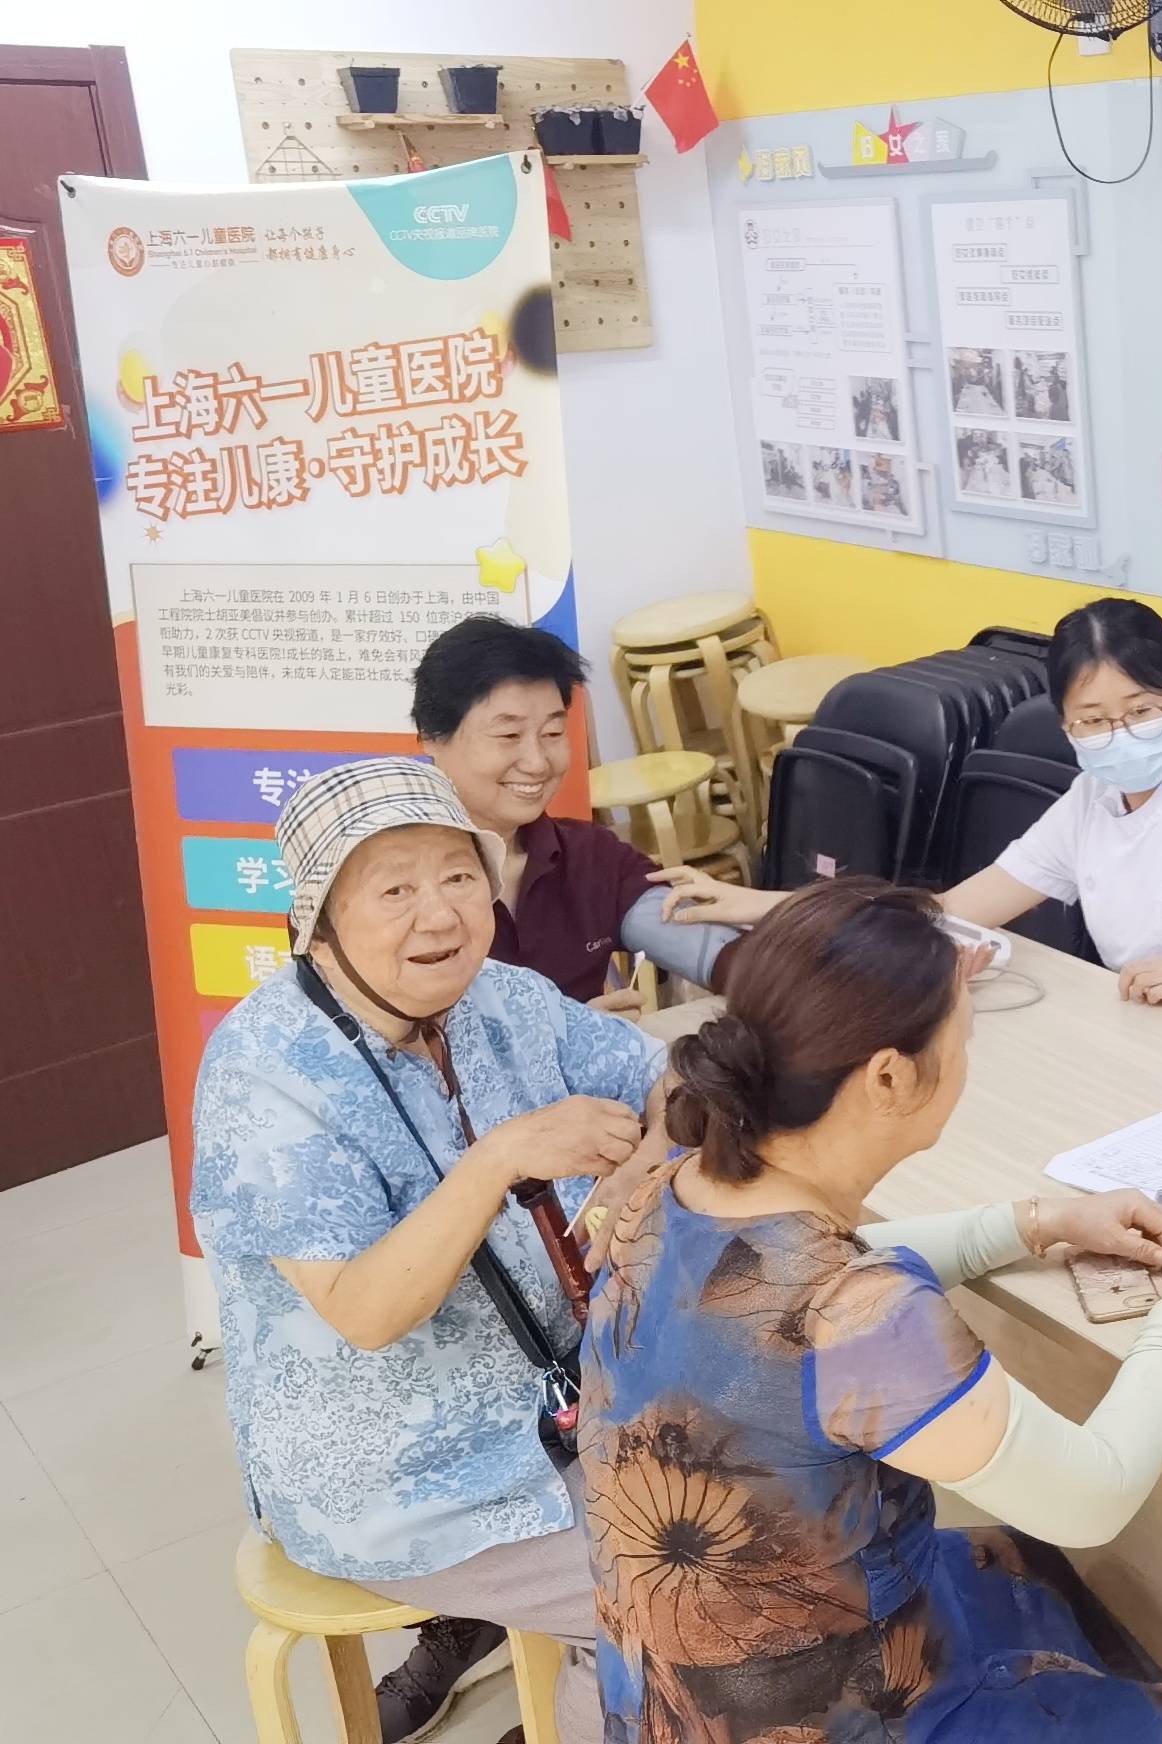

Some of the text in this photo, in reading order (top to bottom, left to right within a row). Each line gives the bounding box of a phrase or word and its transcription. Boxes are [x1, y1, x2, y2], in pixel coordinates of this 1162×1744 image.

[413, 203, 470, 224] CCTV
[146, 226, 256, 247] 上海六一儿童医院
[131, 327, 504, 443] 上海六一儿童医院
[126, 409, 529, 521] 专注儿康·守护成长
[180, 588, 285, 604] 上海六一儿童医院在
[288, 590, 315, 604] 2009
[319, 590, 332, 604] 年
[349, 591, 359, 605] 月
[400, 610, 420, 624] 150
[241, 628, 270, 641] CCTV
[272, 628, 440, 645] 央视报道，是一家疗效好、口碑
[245, 944, 293, 982] 语
